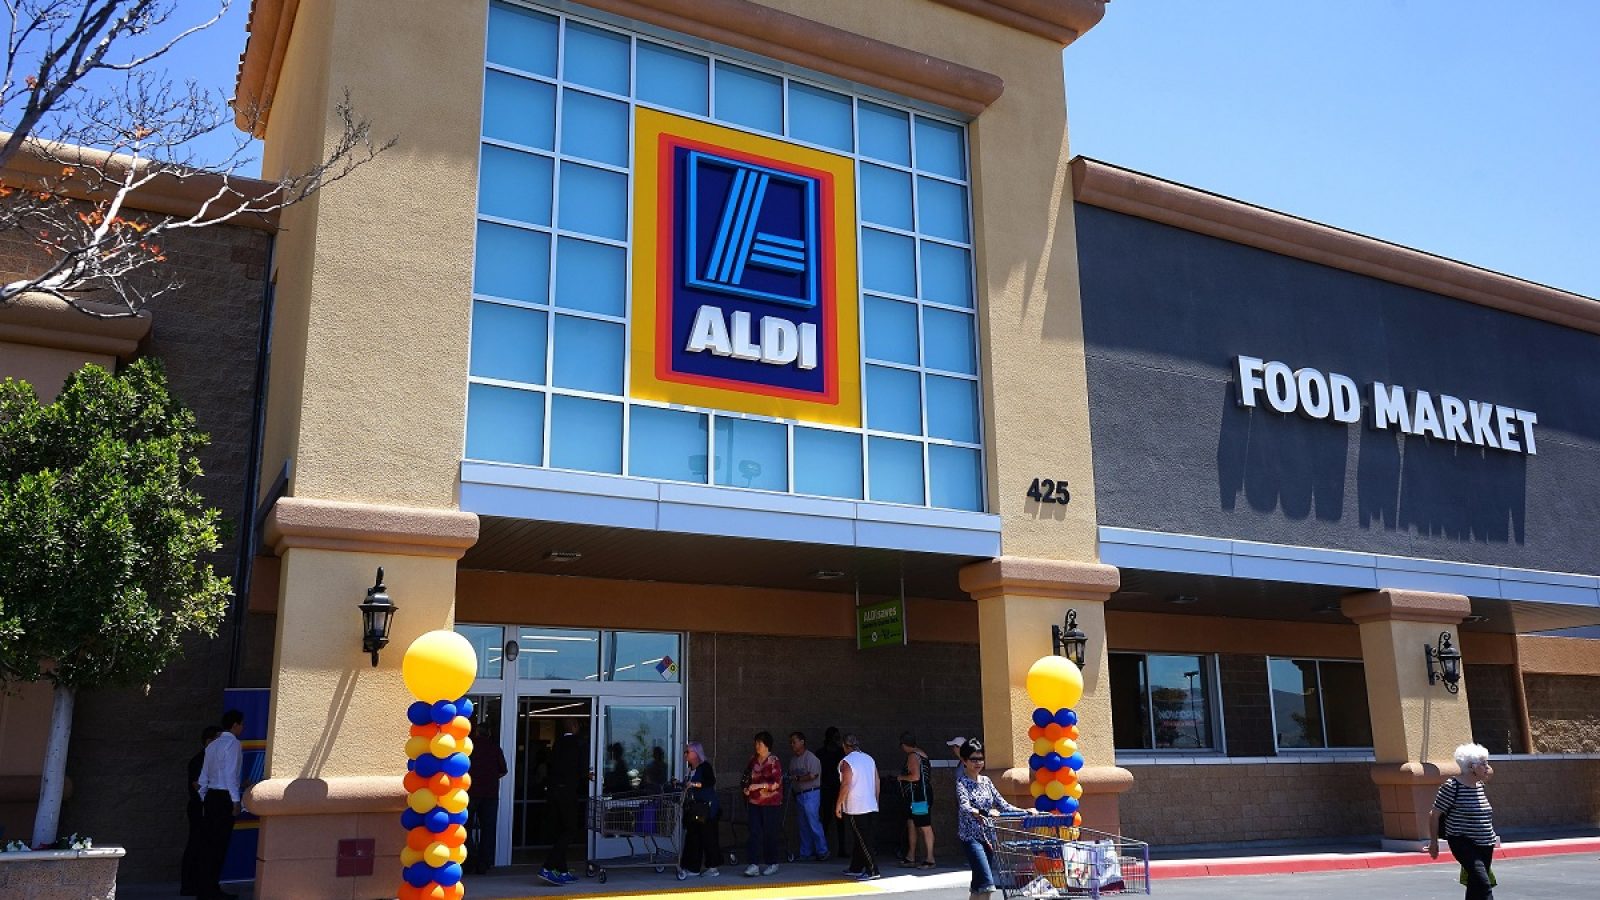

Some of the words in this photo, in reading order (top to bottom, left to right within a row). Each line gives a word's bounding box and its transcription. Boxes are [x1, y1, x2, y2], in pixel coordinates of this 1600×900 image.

[686, 305, 817, 370] ALDI
[1234, 355, 1361, 424] FOOD
[1372, 381, 1538, 456] MARKET
[1026, 478, 1070, 505] 425
